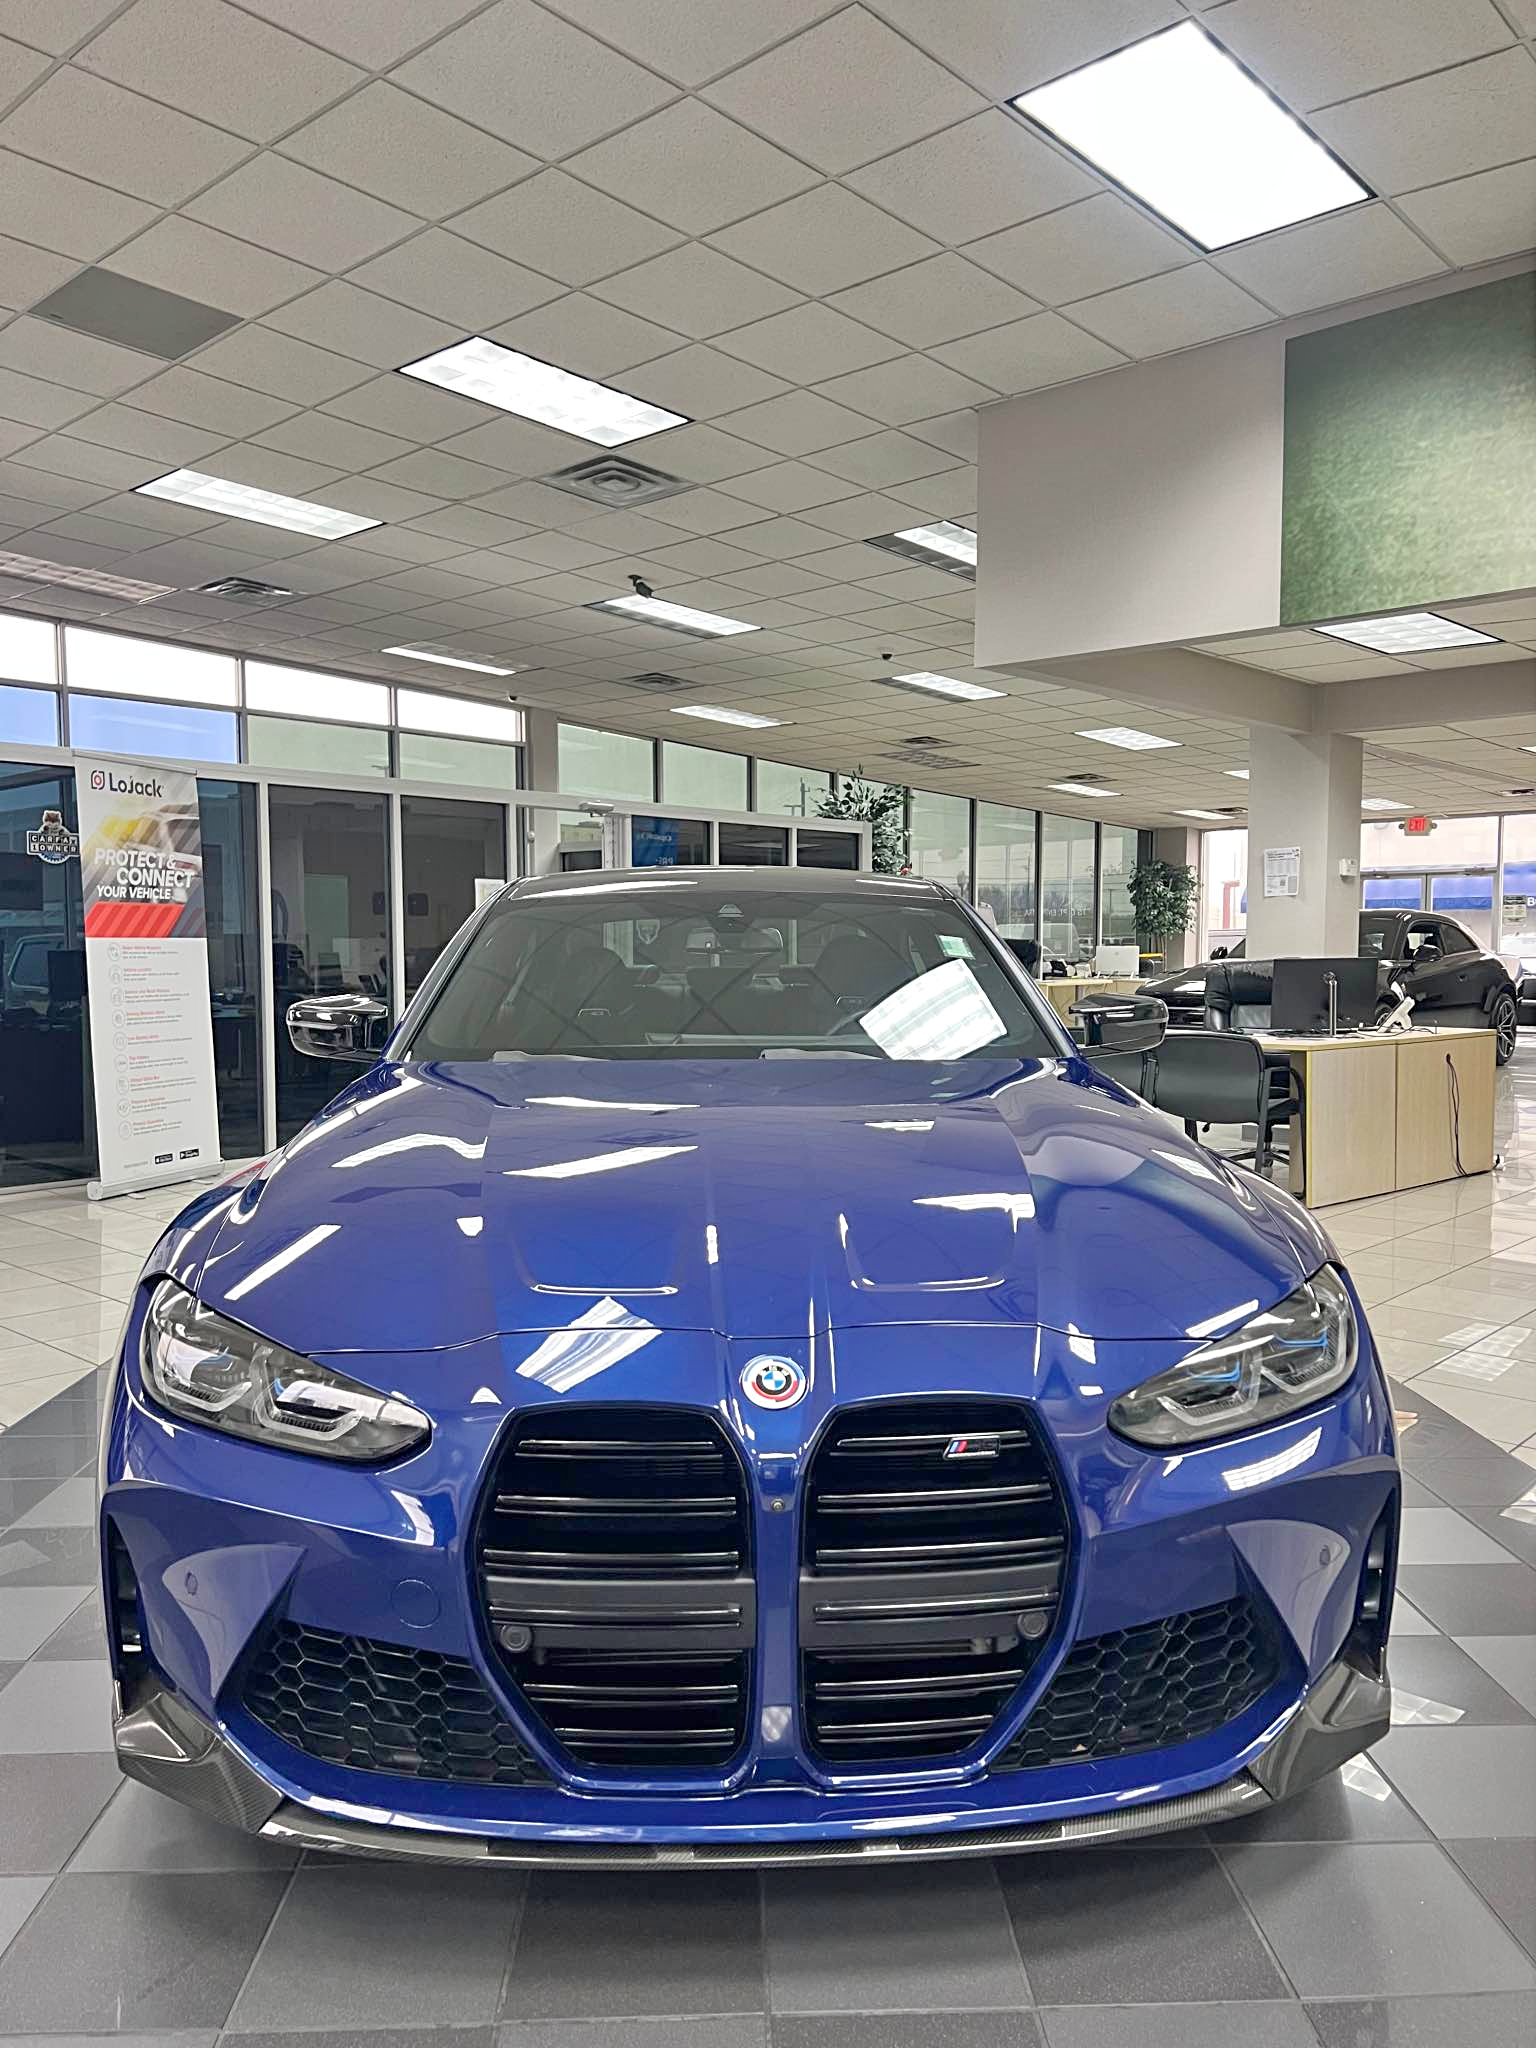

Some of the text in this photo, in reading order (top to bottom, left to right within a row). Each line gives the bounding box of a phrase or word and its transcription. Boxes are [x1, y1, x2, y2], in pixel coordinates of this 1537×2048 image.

[95, 848, 176, 869] PROTECT &
[117, 867, 195, 888] CONNECT
[97, 885, 171, 900] YOUR VEHICLE
